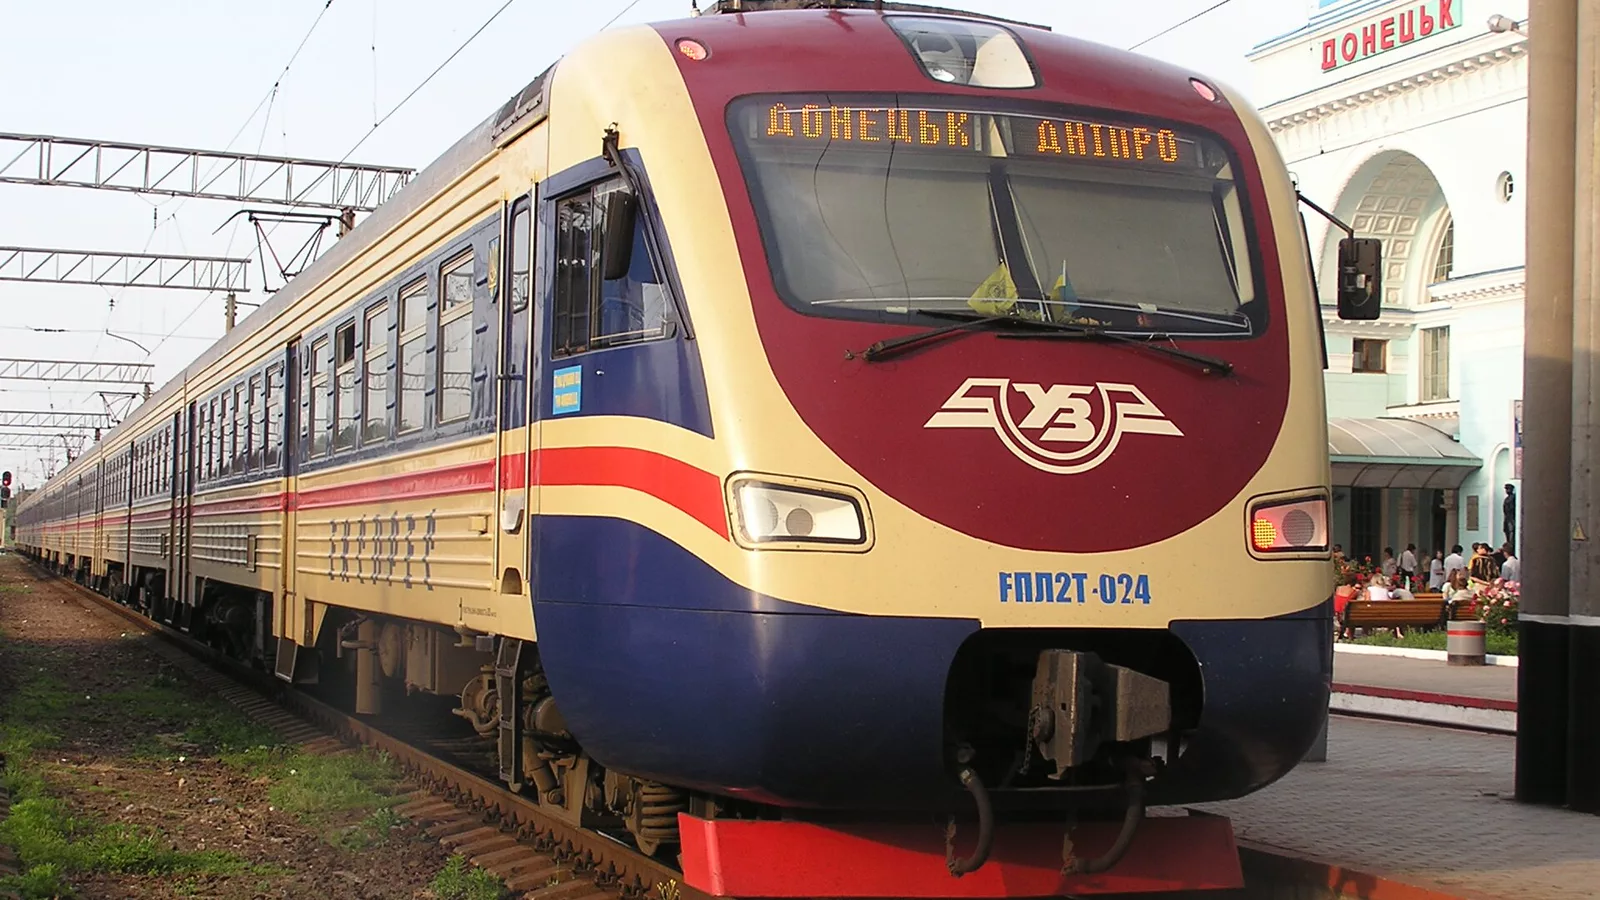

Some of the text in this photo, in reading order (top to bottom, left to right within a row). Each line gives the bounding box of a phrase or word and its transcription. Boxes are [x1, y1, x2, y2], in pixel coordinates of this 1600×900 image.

[1321, 0, 1455, 71] ДОНЕЦЬК
[767, 102, 970, 147] ДОНЕЦЬК
[1037, 119, 1179, 162] ДНІПРО
